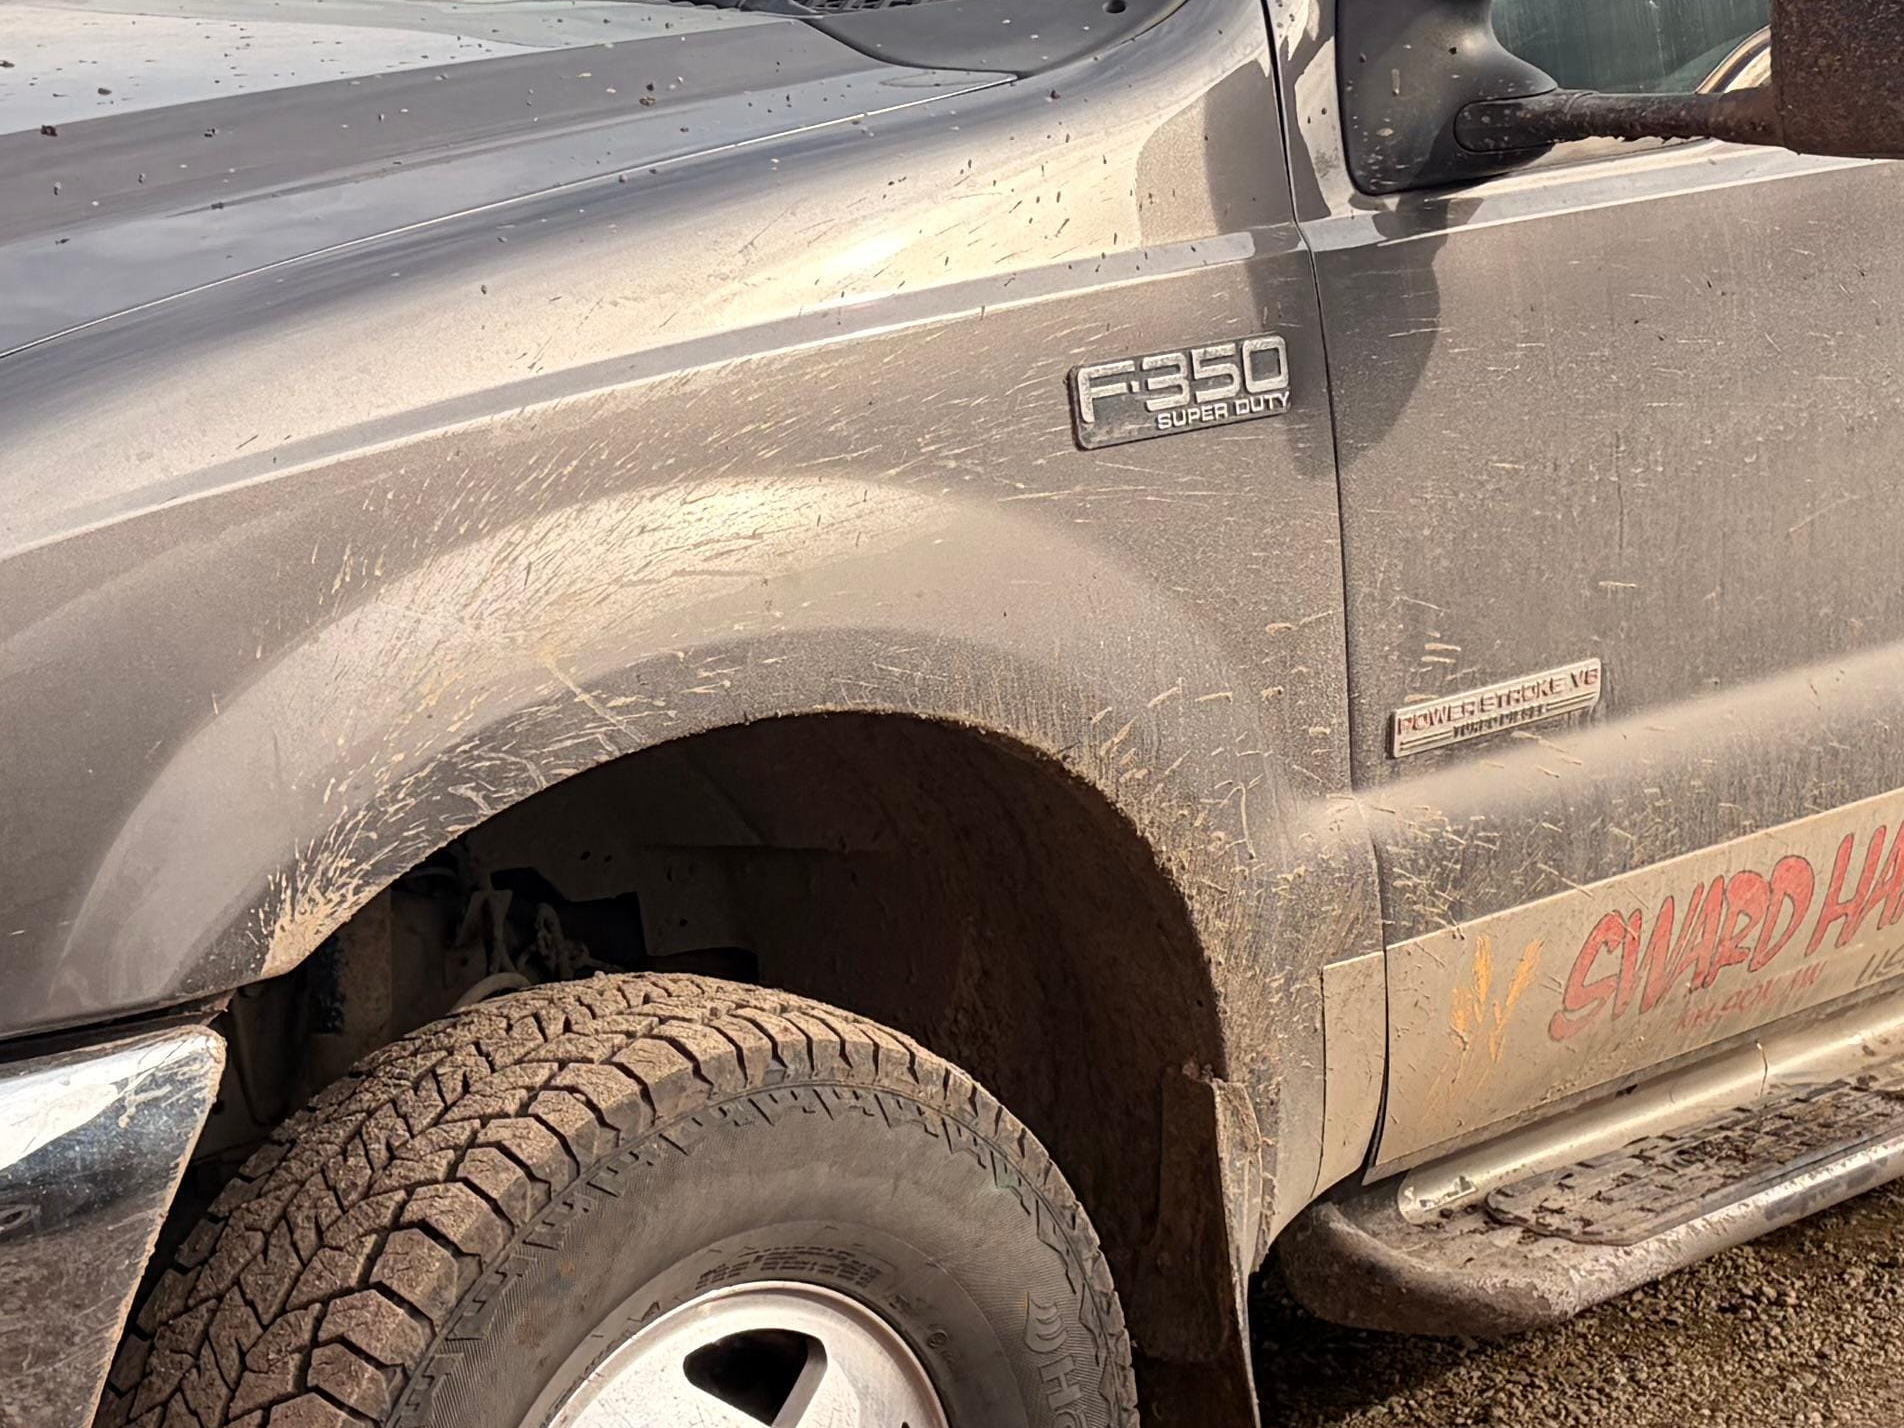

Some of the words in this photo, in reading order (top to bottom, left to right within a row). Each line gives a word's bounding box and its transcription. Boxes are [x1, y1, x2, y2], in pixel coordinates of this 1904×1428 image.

[1157, 403, 1229, 430] SUPER
[1236, 391, 1290, 415] DUTY
[1397, 700, 1476, 735] POWER
[1480, 676, 1563, 713] STROKE
